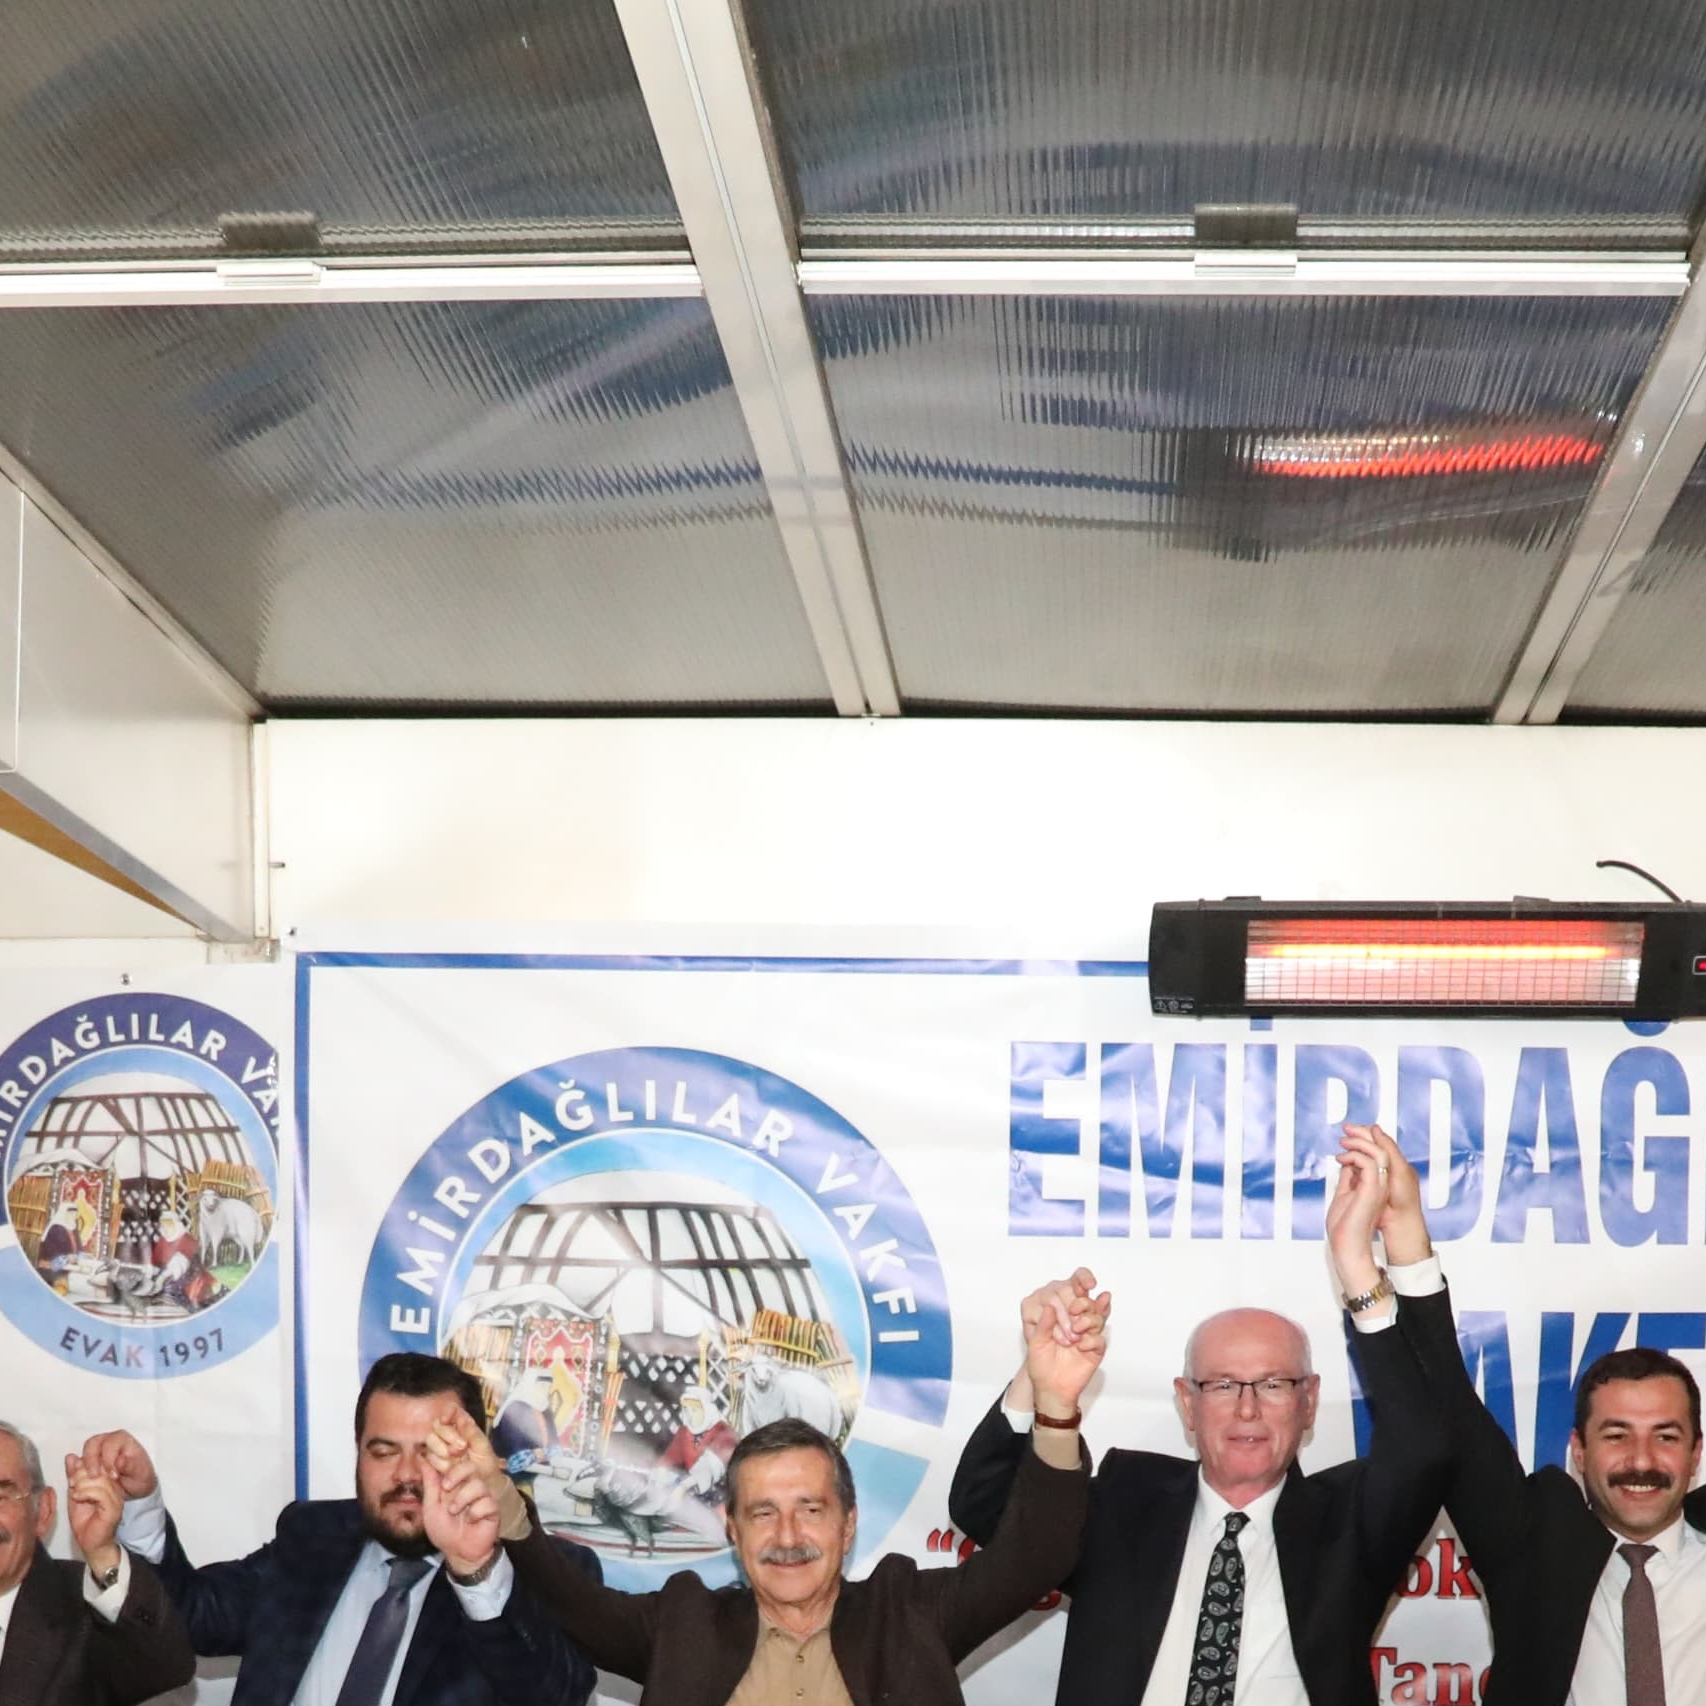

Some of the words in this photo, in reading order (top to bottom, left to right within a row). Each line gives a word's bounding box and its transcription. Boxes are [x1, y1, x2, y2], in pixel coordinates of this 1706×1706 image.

[390, 1079, 793, 1336] EMİRDAĞLILAR
[817, 1153, 921, 1344] VAKFI
[59, 1327, 144, 1368] EVAK
[159, 1328, 224, 1368] 1997
